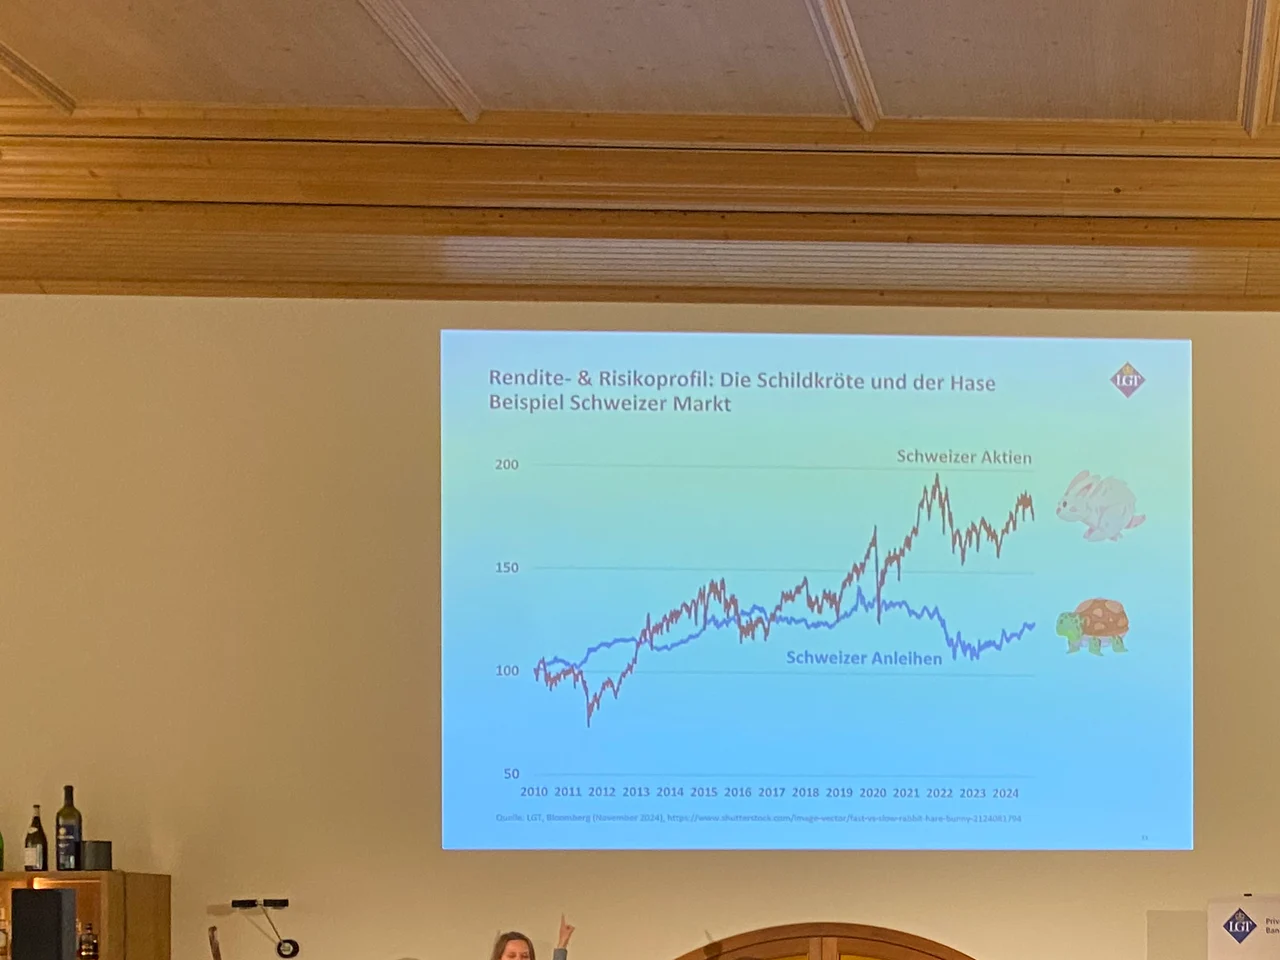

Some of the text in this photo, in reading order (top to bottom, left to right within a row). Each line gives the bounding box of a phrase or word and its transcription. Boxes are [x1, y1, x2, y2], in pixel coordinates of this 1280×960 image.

[489, 369, 996, 391] Rendite- & Risikoprofil: Die Schildkröte und der Hase
[1115, 374, 1142, 387] LGT
[489, 394, 732, 414] Beispiel Schweizer Markt
[897, 448, 1033, 465] Schweizer Aktien
[494, 459, 519, 471] 200
[495, 562, 519, 574] 150
[786, 650, 943, 666] Schweizer Anleihen
[495, 665, 520, 677] 100
[503, 768, 520, 780] 50
[520, 786, 1019, 798] 2010 2011 2012 2013 2014 2015 2016 2017 2018 2019 2020 2021 2022 2023 2024
[546, 813, 591, 825] Bloomberg
[592, 813, 638, 825] (November
[1228, 921, 1253, 933] LGT
